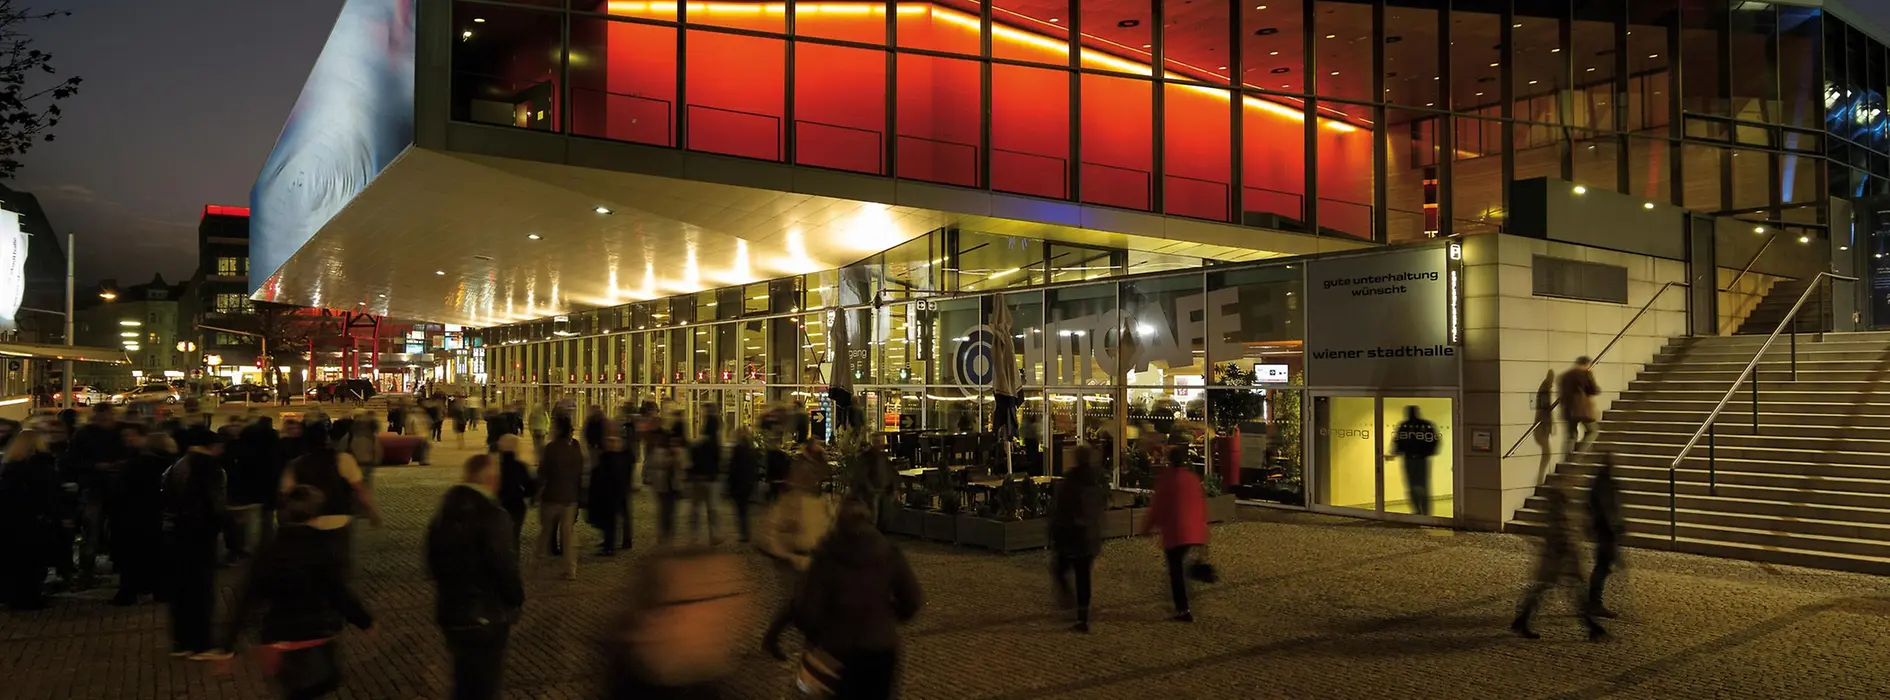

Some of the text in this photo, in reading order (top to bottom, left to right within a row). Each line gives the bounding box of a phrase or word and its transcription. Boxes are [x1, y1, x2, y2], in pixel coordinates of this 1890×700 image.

[1323, 271, 1439, 289] gute unterhaltung
[1351, 284, 1407, 296] wünscht
[1312, 345, 1454, 359] wiener stadthalle
